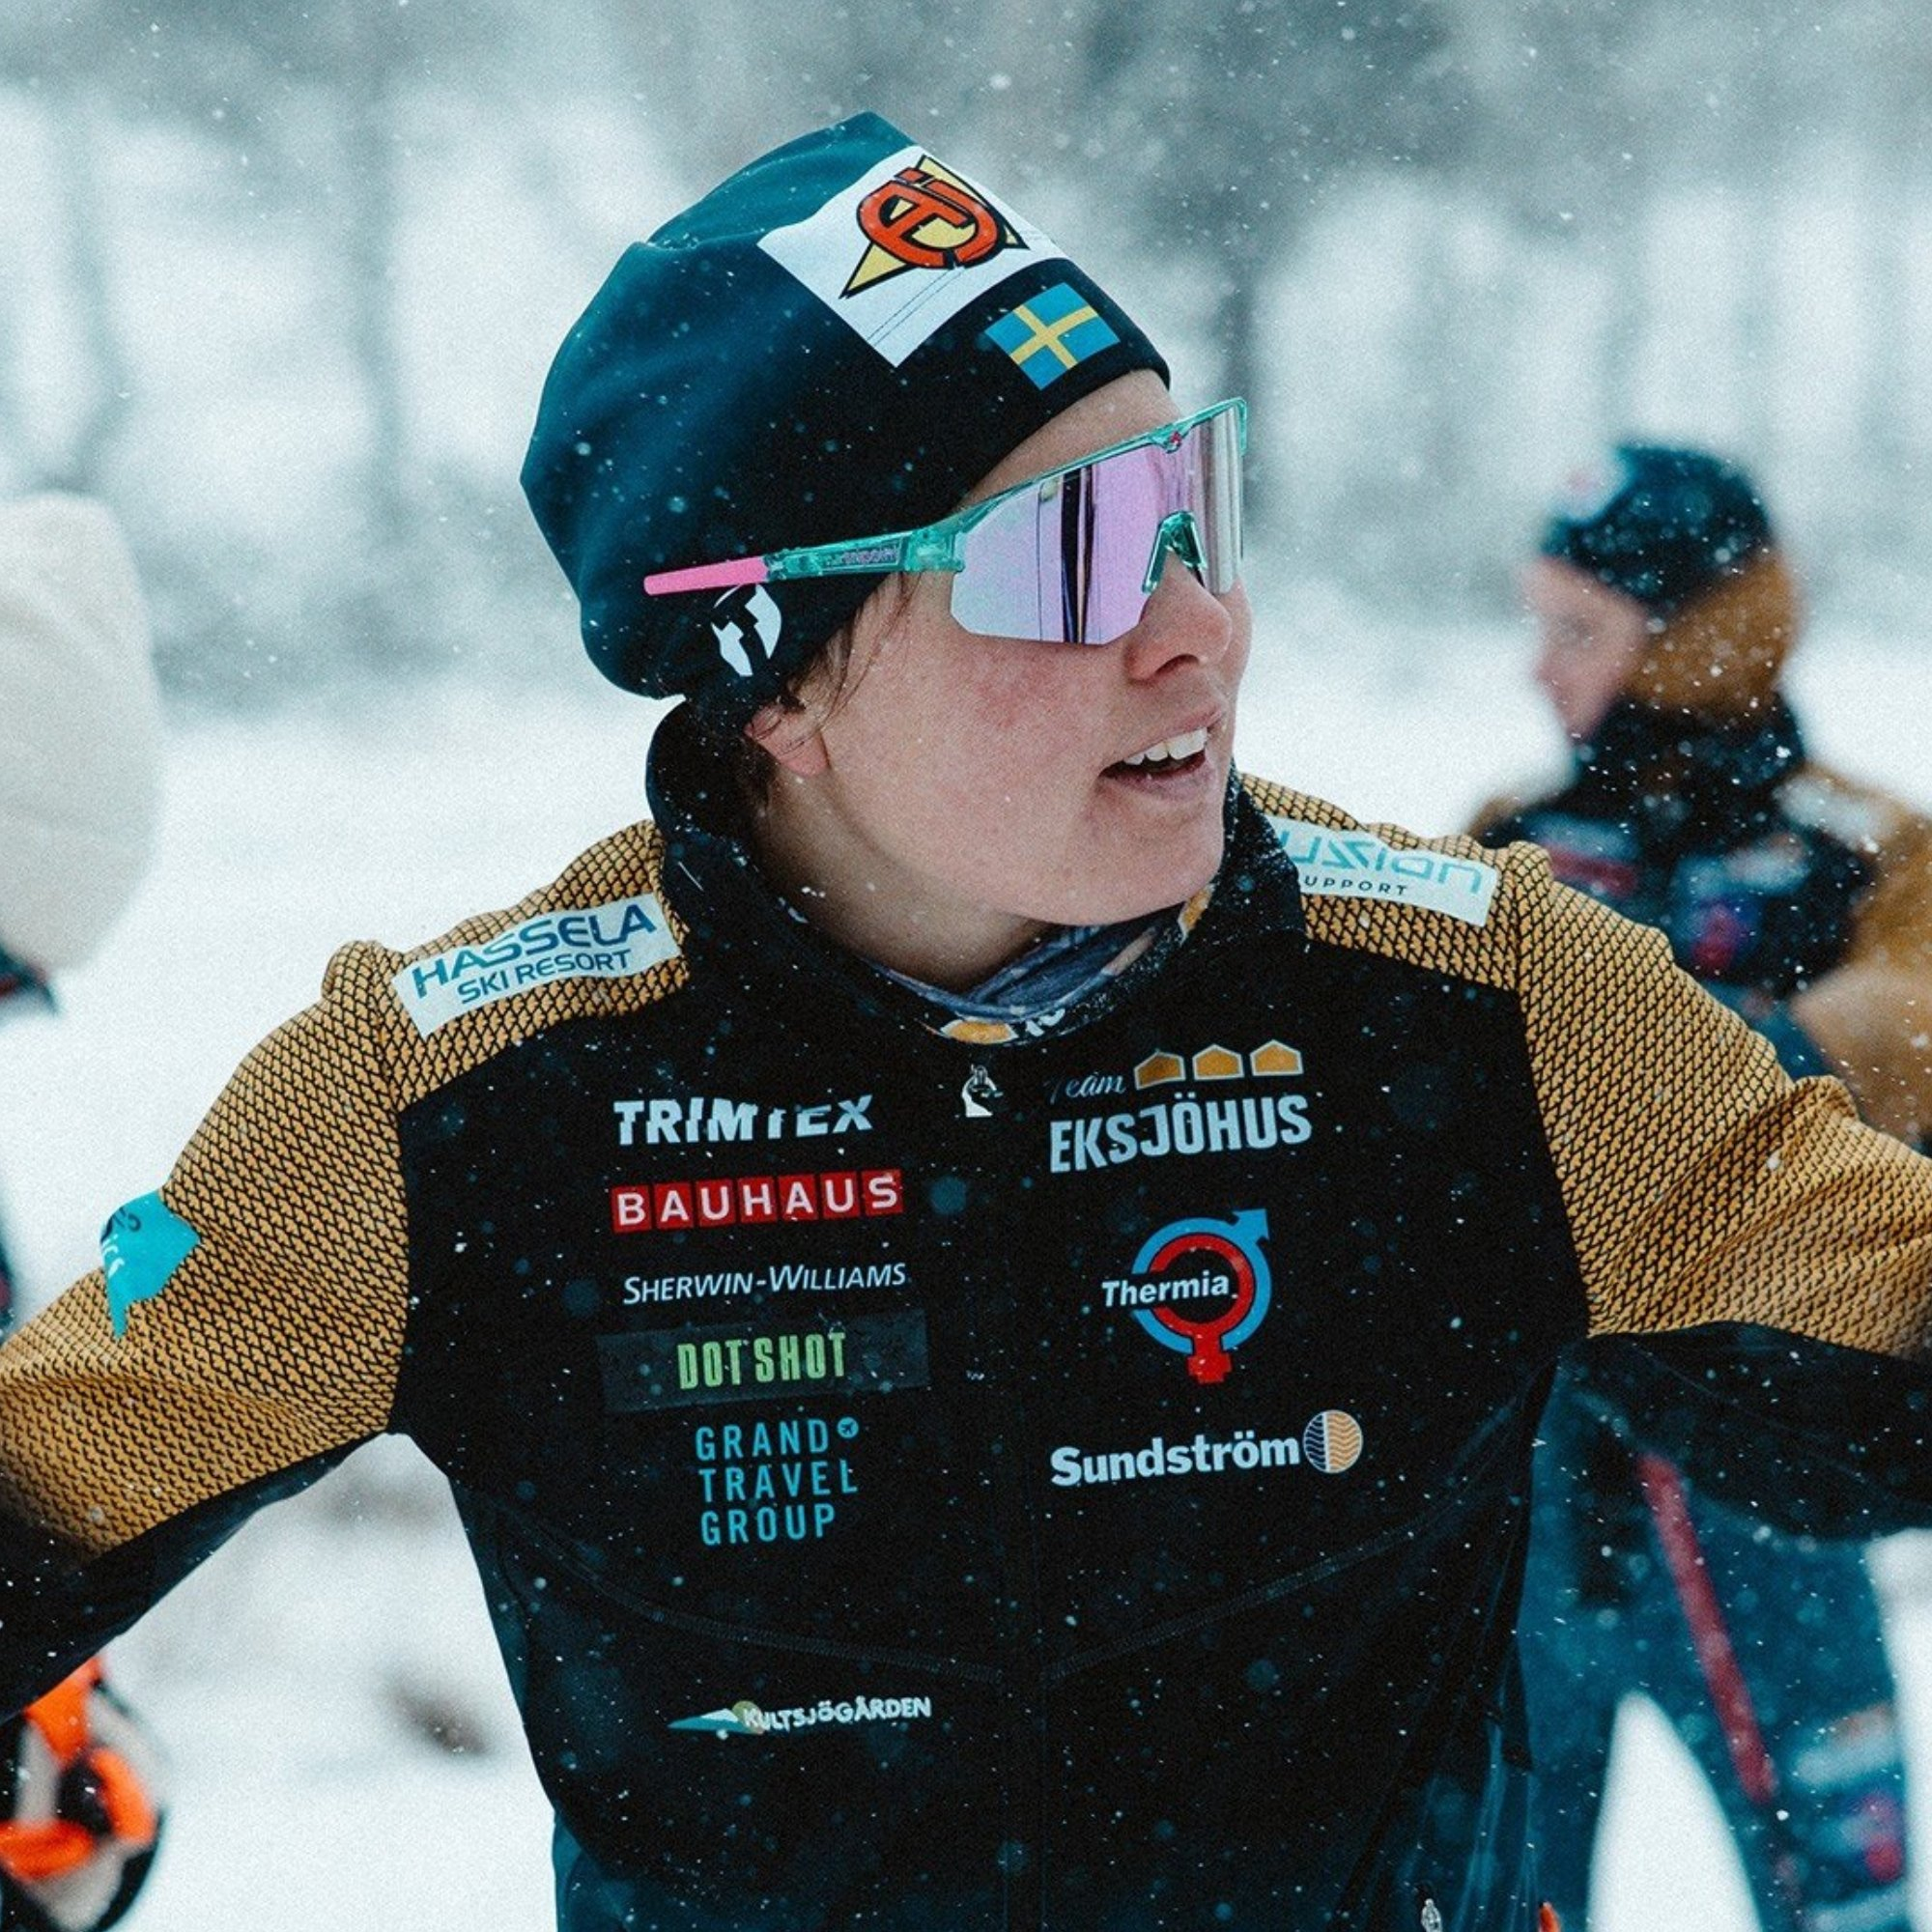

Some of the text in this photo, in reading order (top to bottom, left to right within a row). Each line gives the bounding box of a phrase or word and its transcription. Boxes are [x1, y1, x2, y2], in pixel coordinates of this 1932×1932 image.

[1304, 874, 1408, 896] UPPORT
[412, 903, 658, 999] HASSELA
[458, 949, 632, 1005] SKI RESORT
[1049, 1092, 1313, 1174] EKSJÖHUS
[616, 1175, 899, 1226] BAUHAUS
[623, 1262, 907, 1305] SHERWIN-WILLIAMS
[1101, 1269, 1230, 1307] Thermia
[695, 1418, 829, 1462] GRAND
[1050, 1430, 1300, 1487] Sundström
[698, 1459, 859, 1503] TRAVEL
[700, 1503, 836, 1546] GROUP
[743, 1694, 932, 1732] KULTSJÖGÅRDEN
